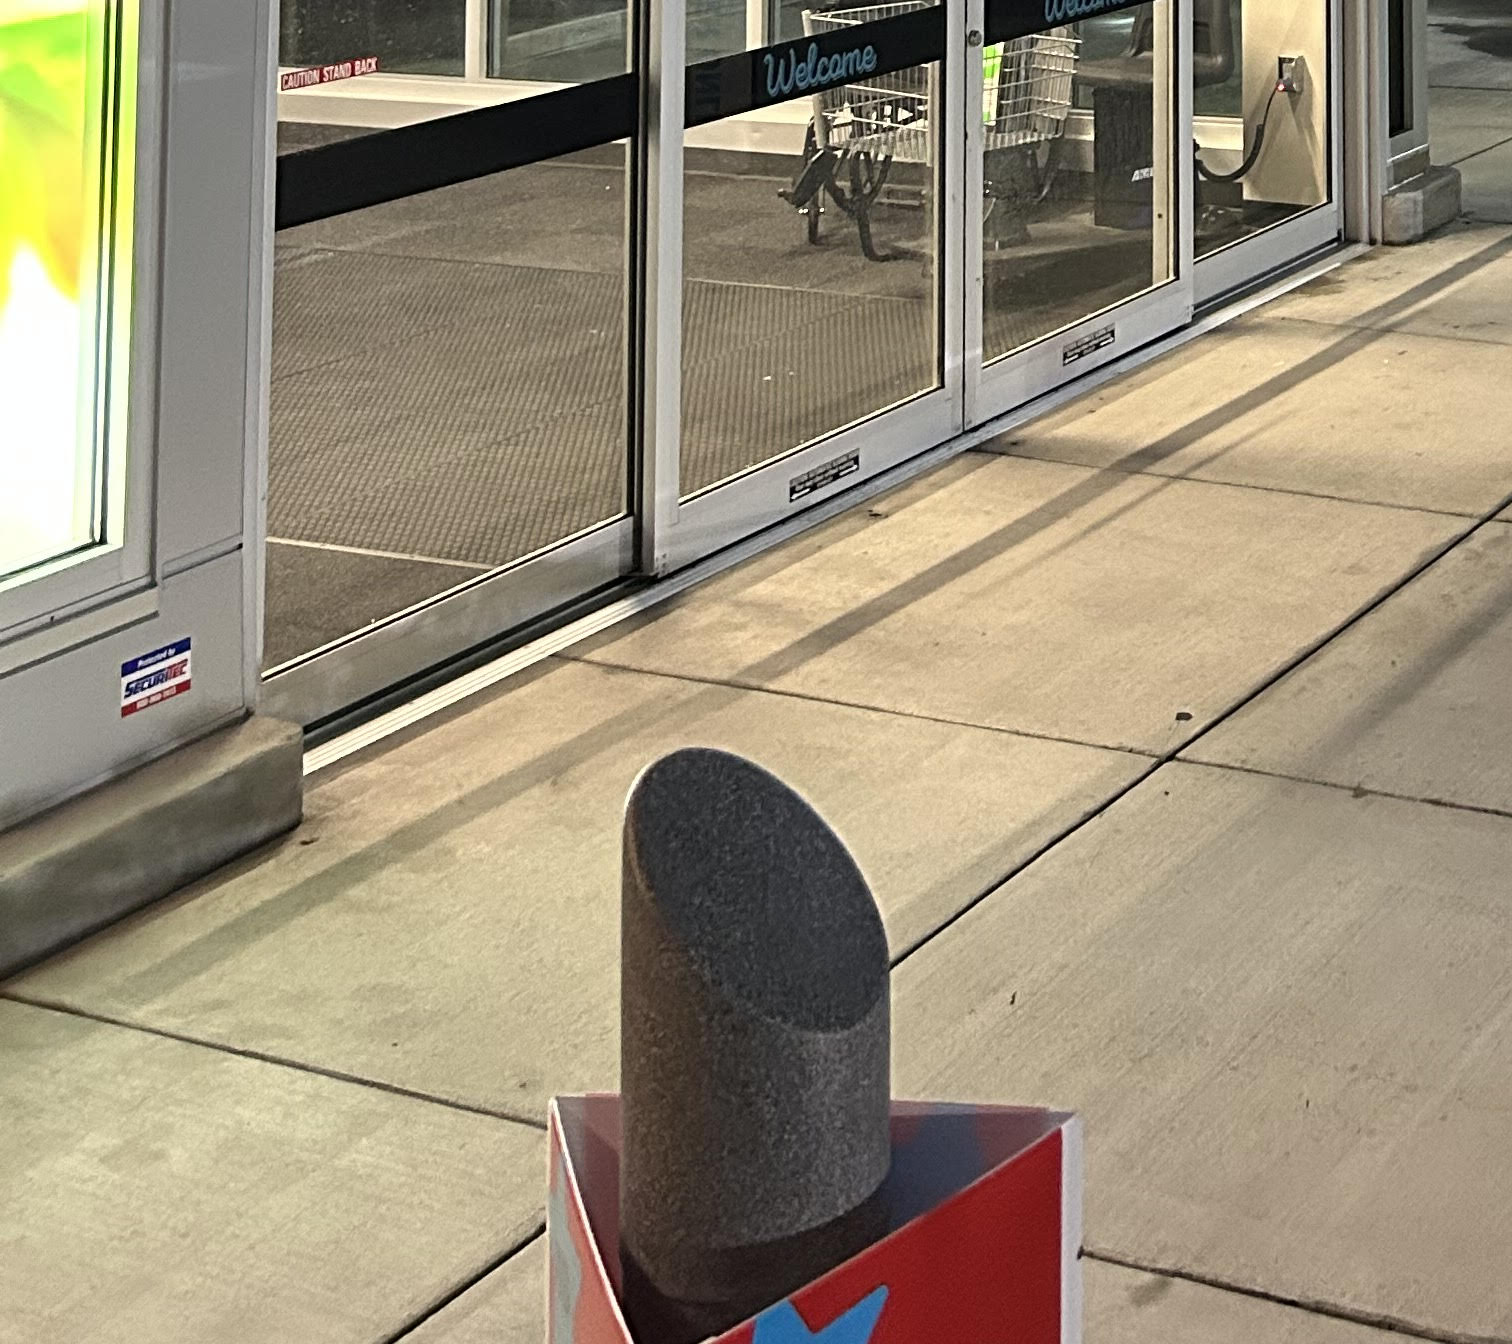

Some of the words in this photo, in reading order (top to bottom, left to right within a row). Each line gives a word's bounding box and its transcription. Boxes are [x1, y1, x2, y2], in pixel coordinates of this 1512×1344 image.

[282, 69, 320, 90] CAUTION
[322, 62, 352, 82] STAND
[354, 57, 378, 75] BACK
[764, 42, 877, 97] Welcome
